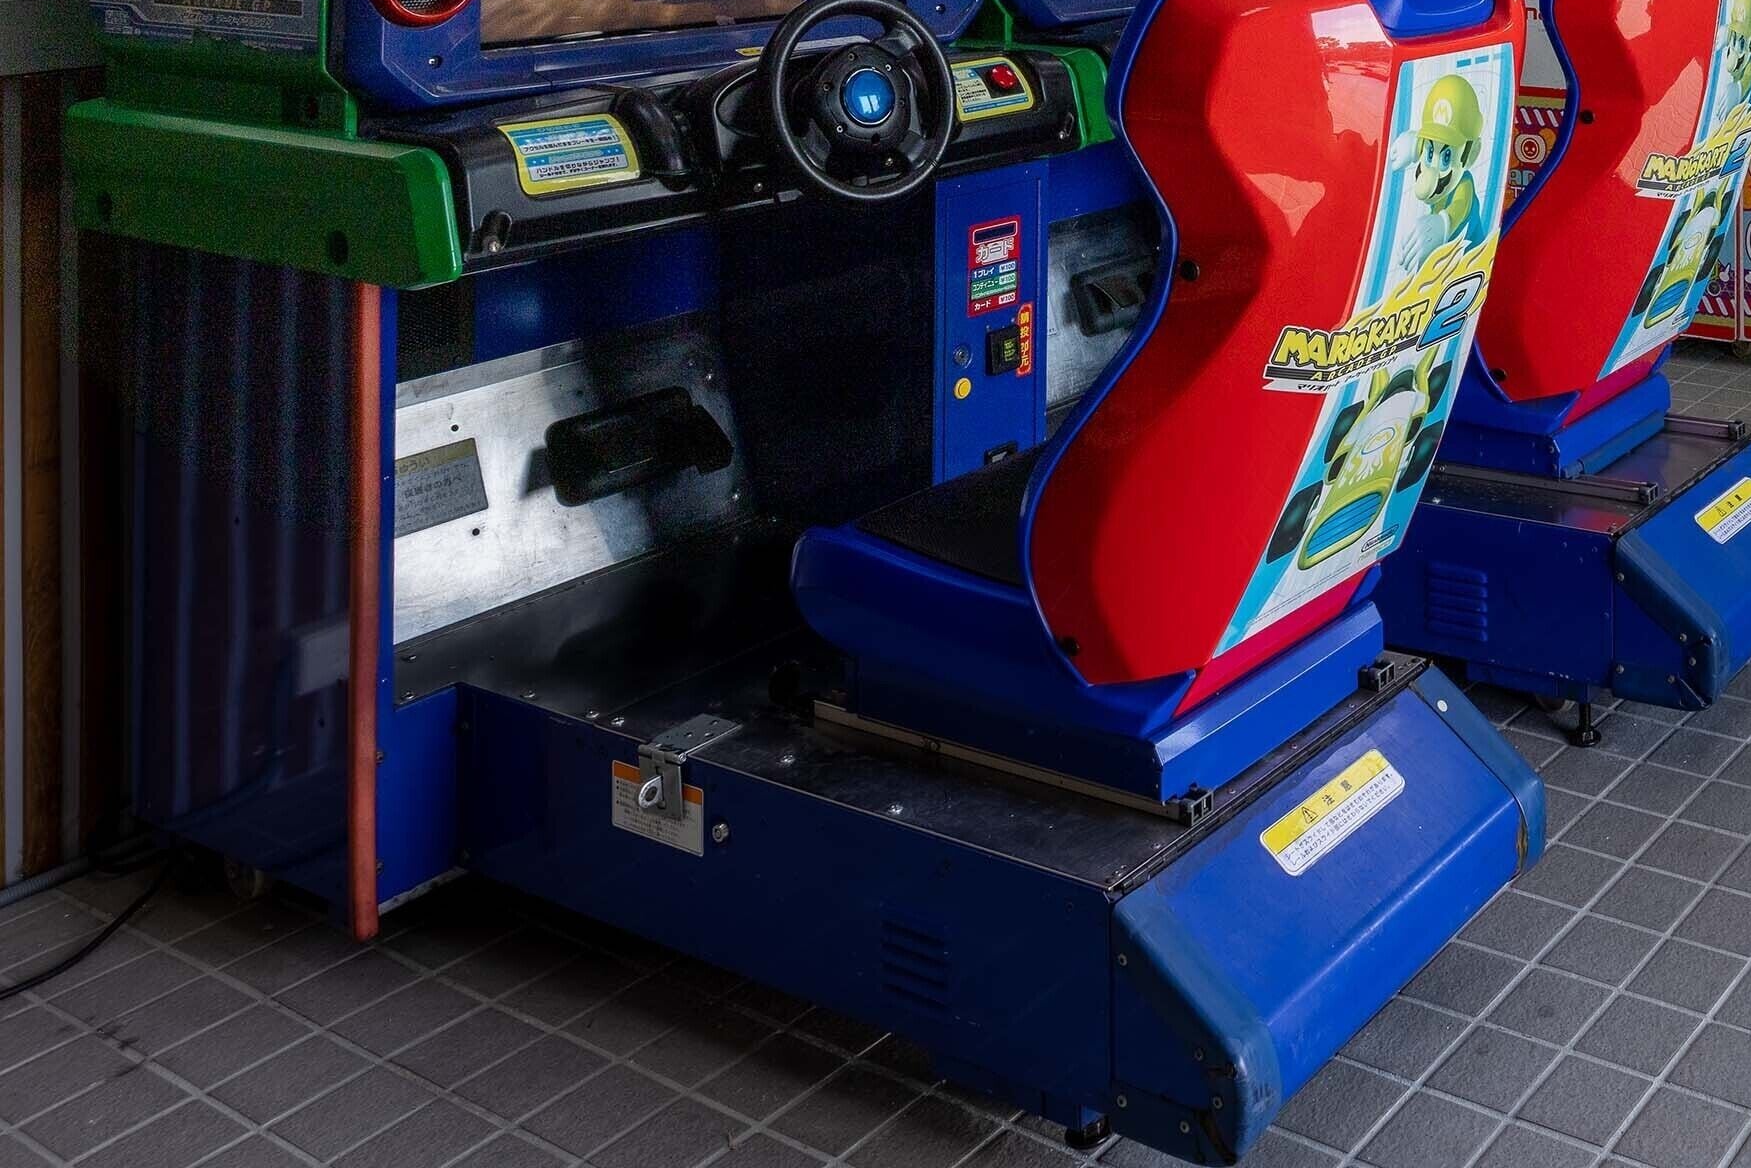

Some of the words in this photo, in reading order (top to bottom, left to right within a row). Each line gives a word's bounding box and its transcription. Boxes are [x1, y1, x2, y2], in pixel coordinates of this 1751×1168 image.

[975, 236, 1015, 264] カード
[973, 267, 995, 279] 1プレイ
[974, 300, 991, 311] カード
[1415, 270, 1486, 353] 2
[1311, 355, 1375, 382] ARCADE
[1379, 344, 1398, 363] GP
